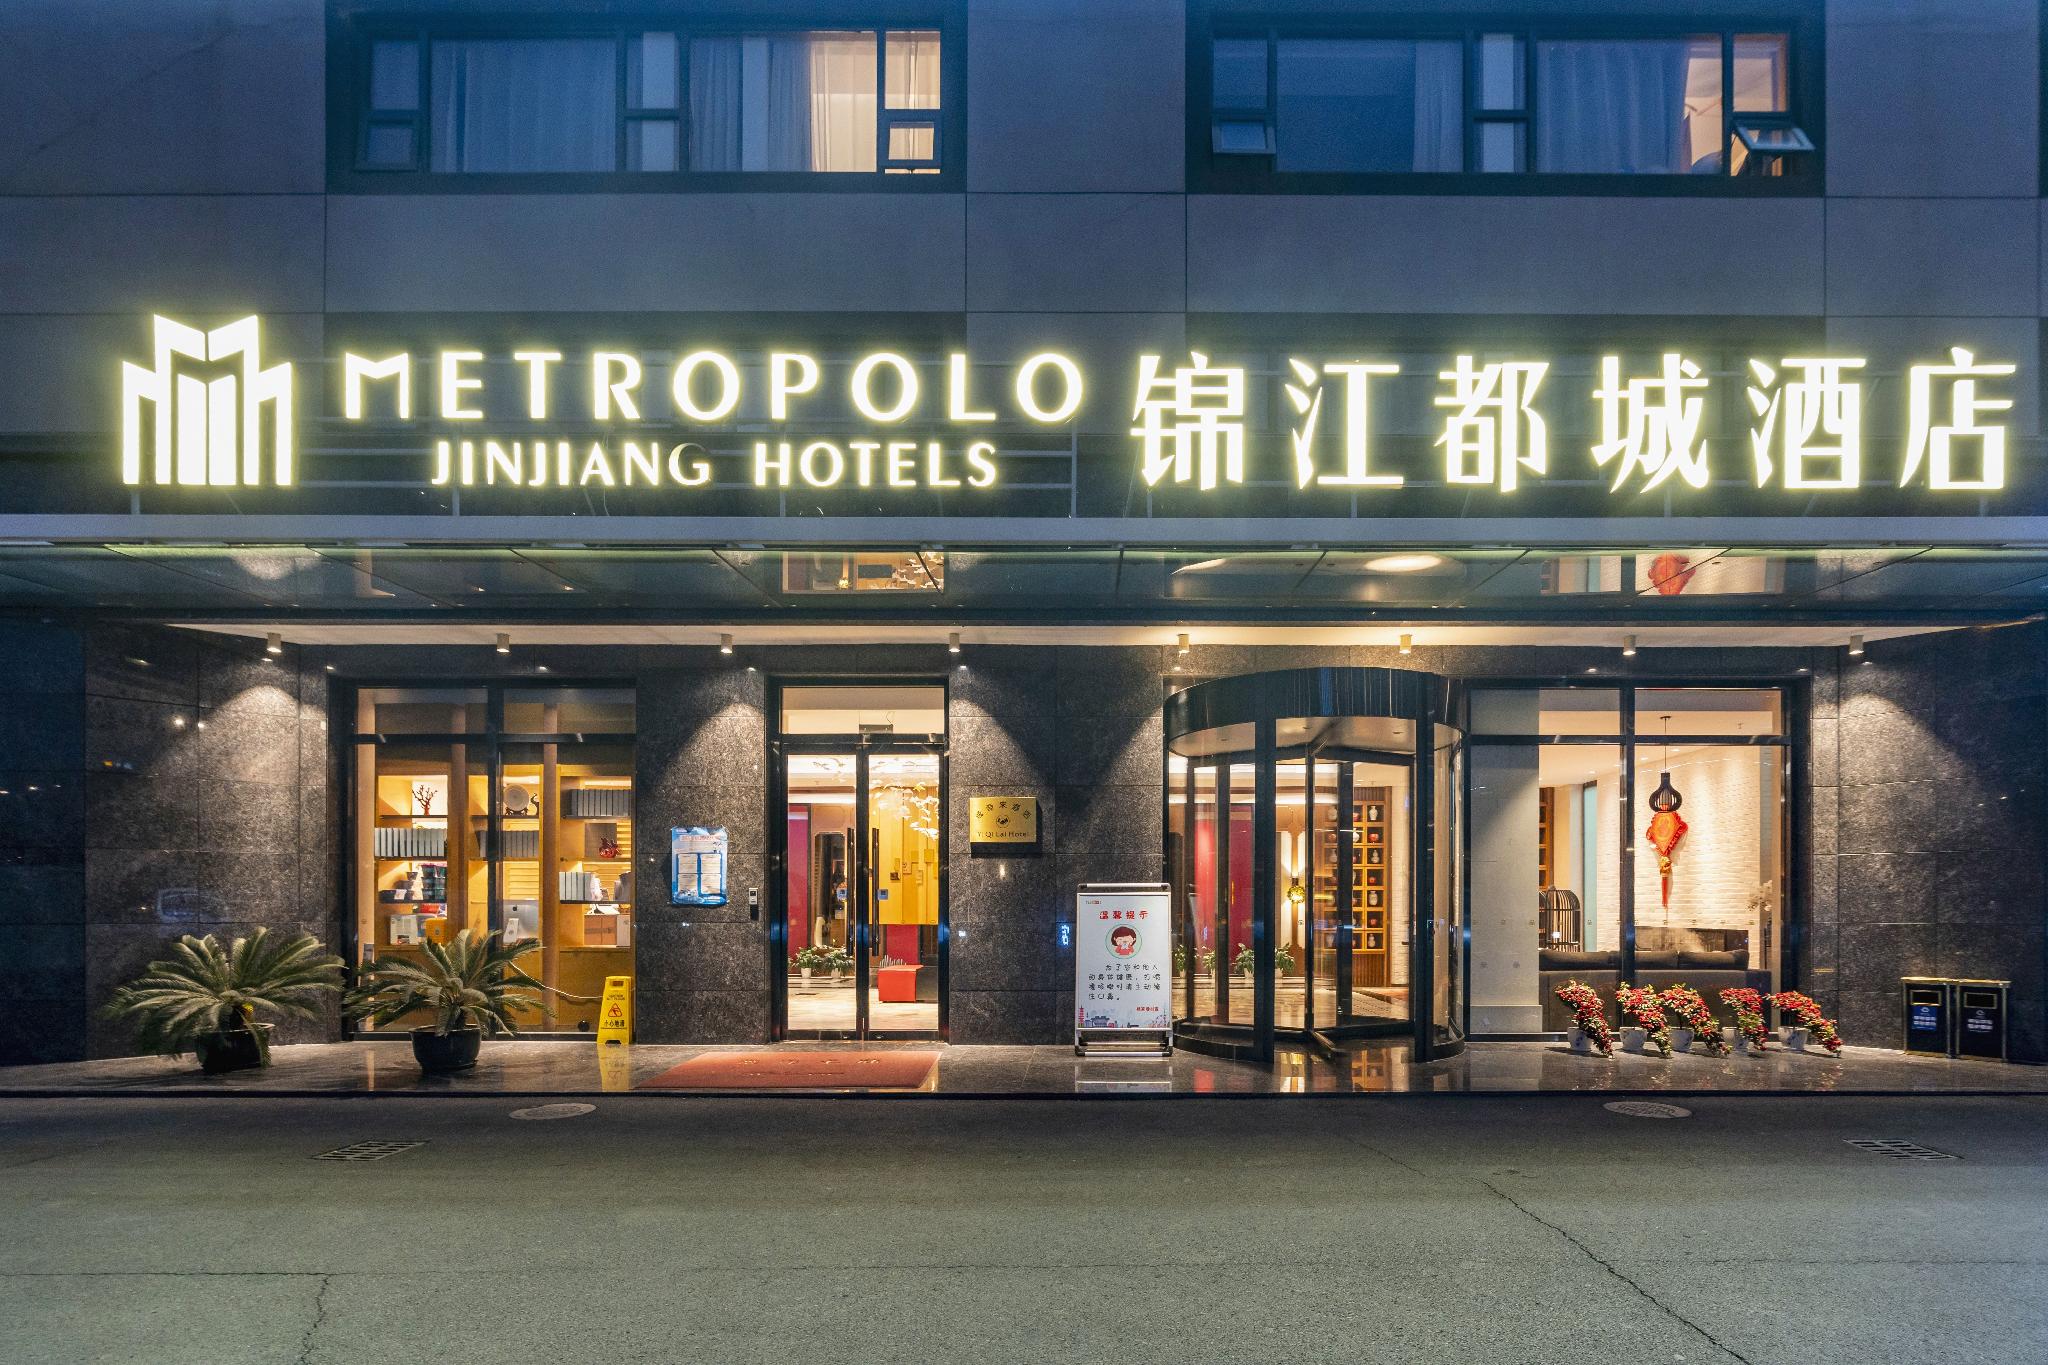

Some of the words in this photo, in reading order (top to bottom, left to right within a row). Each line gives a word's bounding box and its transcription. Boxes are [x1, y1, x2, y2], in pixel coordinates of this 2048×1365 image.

[345, 351, 1083, 421] METROPOLO
[1131, 346, 2018, 494] 锦江都城酒店
[431, 441, 711, 486] JINJIANG
[754, 441, 997, 487] HOTELS
[1099, 910, 1149, 920] 温馨提示
